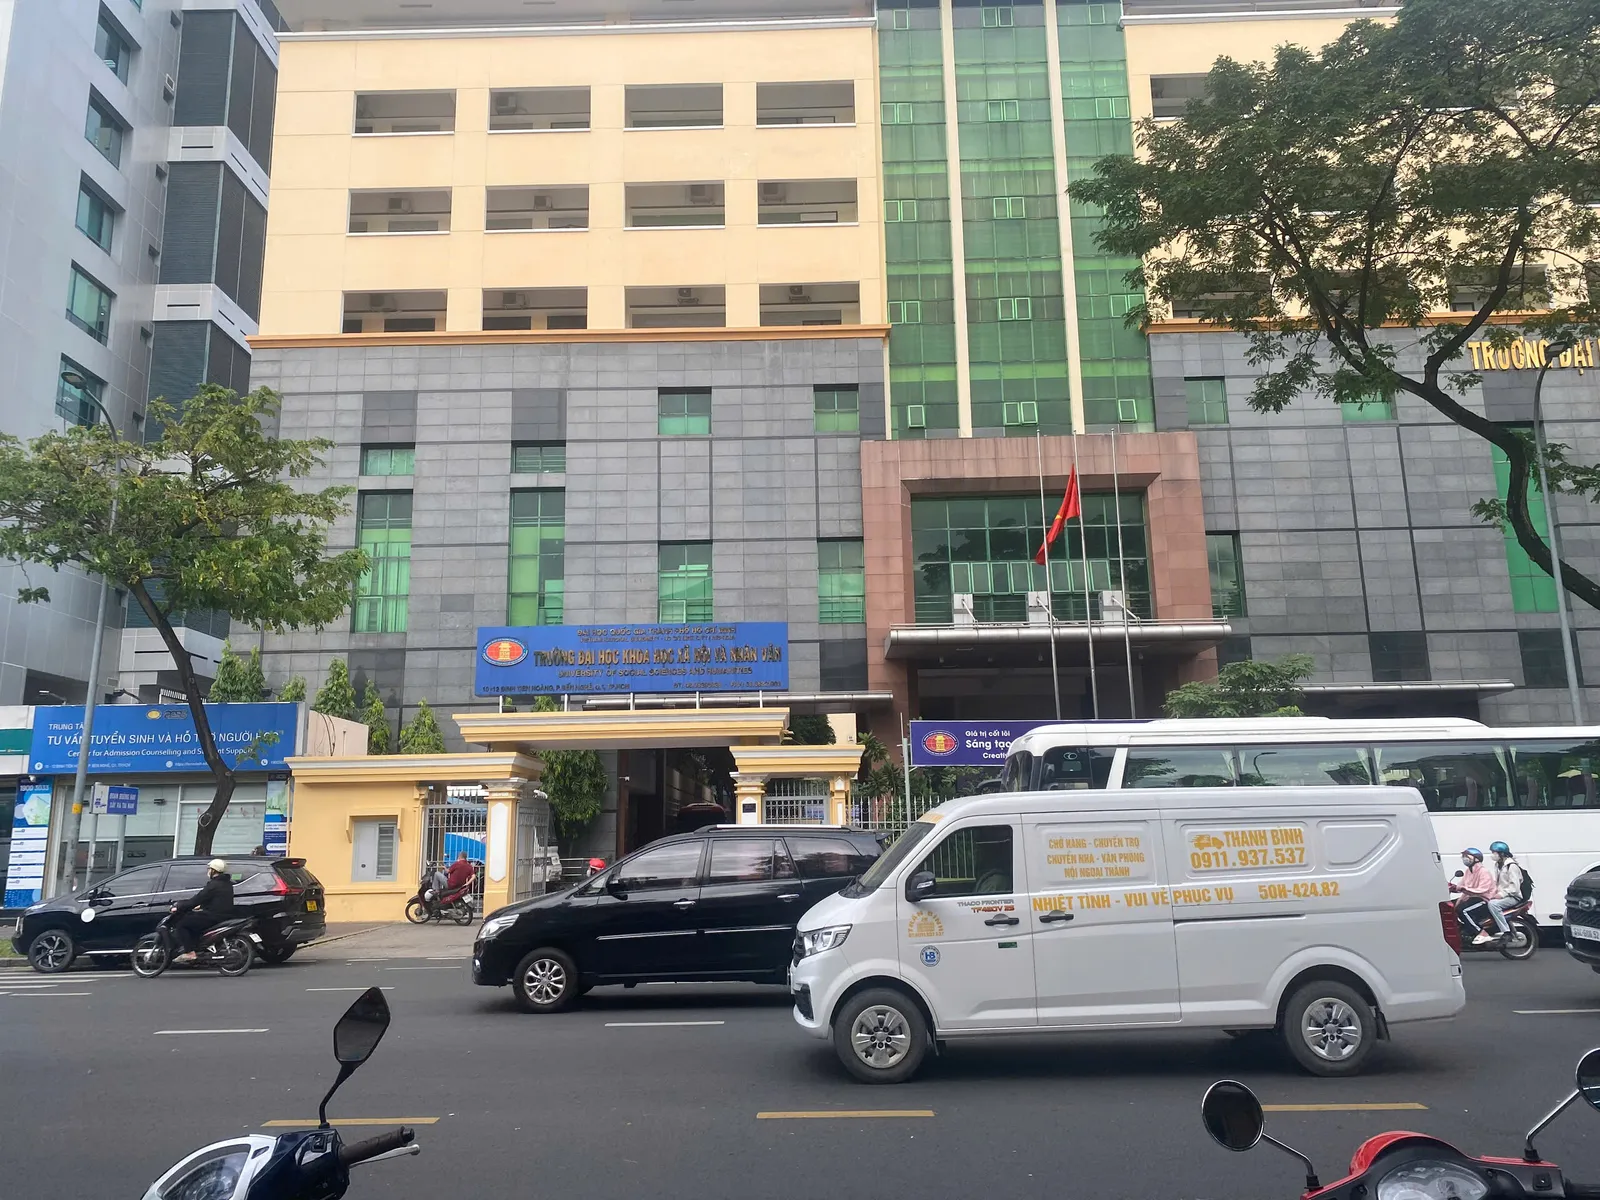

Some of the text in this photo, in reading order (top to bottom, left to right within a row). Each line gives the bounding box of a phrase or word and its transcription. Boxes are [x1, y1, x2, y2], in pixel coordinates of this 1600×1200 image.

[610, 626, 631, 636] QUỐC
[633, 628, 646, 636] GIA
[533, 646, 576, 667] TRƯỜNG
[577, 650, 595, 668] ĐẠI
[598, 649, 620, 668] HỌC
[622, 649, 650, 664] KHOA
[653, 648, 674, 668] HỌC
[677, 644, 691, 664] XÃ
[693, 645, 712, 666] HỘI
[714, 644, 727, 663] VÀ
[730, 644, 758, 663] NHÂN
[761, 643, 782, 663] VĂN
[558, 666, 753, 679] UNIVERSITY OF SOCIAL SCIENCES AND HUMANITIES
[48, 722, 84, 731] TRUNG TÂ
[47, 735, 62, 745] TƯ
[90, 731, 126, 744] TUYỂN
[128, 734, 155, 744] SINH
[158, 731, 172, 743] VÀ
[175, 730, 191, 743] HỖ
[218, 730, 253, 742] NGƯỜI
[966, 739, 1012, 750] Sáng tạo
[93, 749, 102, 757] for
[103, 749, 140, 757] Admission
[141, 748, 181, 757] Counselling
[1124, 837, 1140, 849] TRỌ
[1223, 825, 1304, 848] THANH BÌNH
[1190, 847, 1305, 869] 0911.937.537
[1080, 866, 1103, 878] NGOẠI
[1105, 864, 1130, 877] THÀNH
[1257, 881, 1340, 900] 50H-424.82
[1032, 894, 1073, 911] NHIỆT
[1077, 892, 1111, 909] TÌNH
[1124, 892, 1148, 907] VUI
[1151, 887, 1170, 905] VẺ
[1172, 887, 1211, 906] PHỤC
[1215, 887, 1234, 904] VỤ
